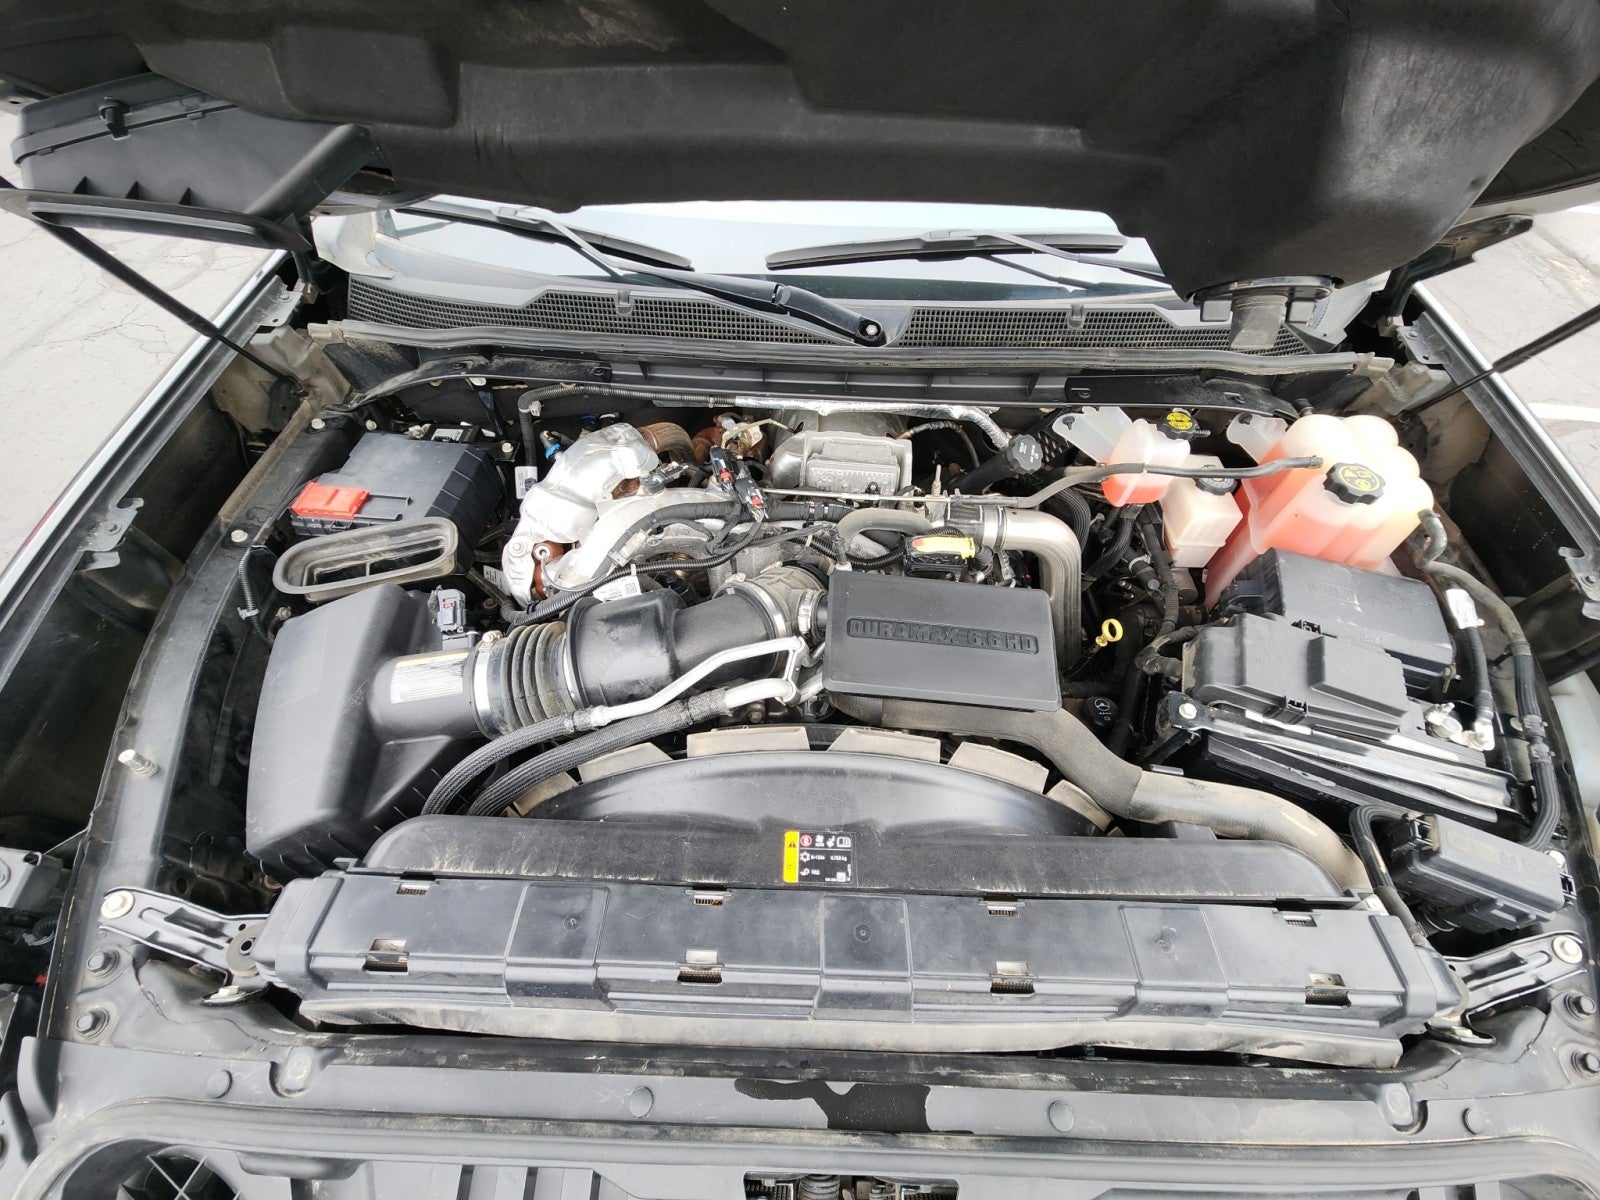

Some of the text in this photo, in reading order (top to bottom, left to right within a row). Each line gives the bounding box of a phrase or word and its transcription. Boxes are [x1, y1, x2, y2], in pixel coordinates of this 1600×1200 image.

[850, 619, 1036, 651] DURAMAX 6.6 HD
